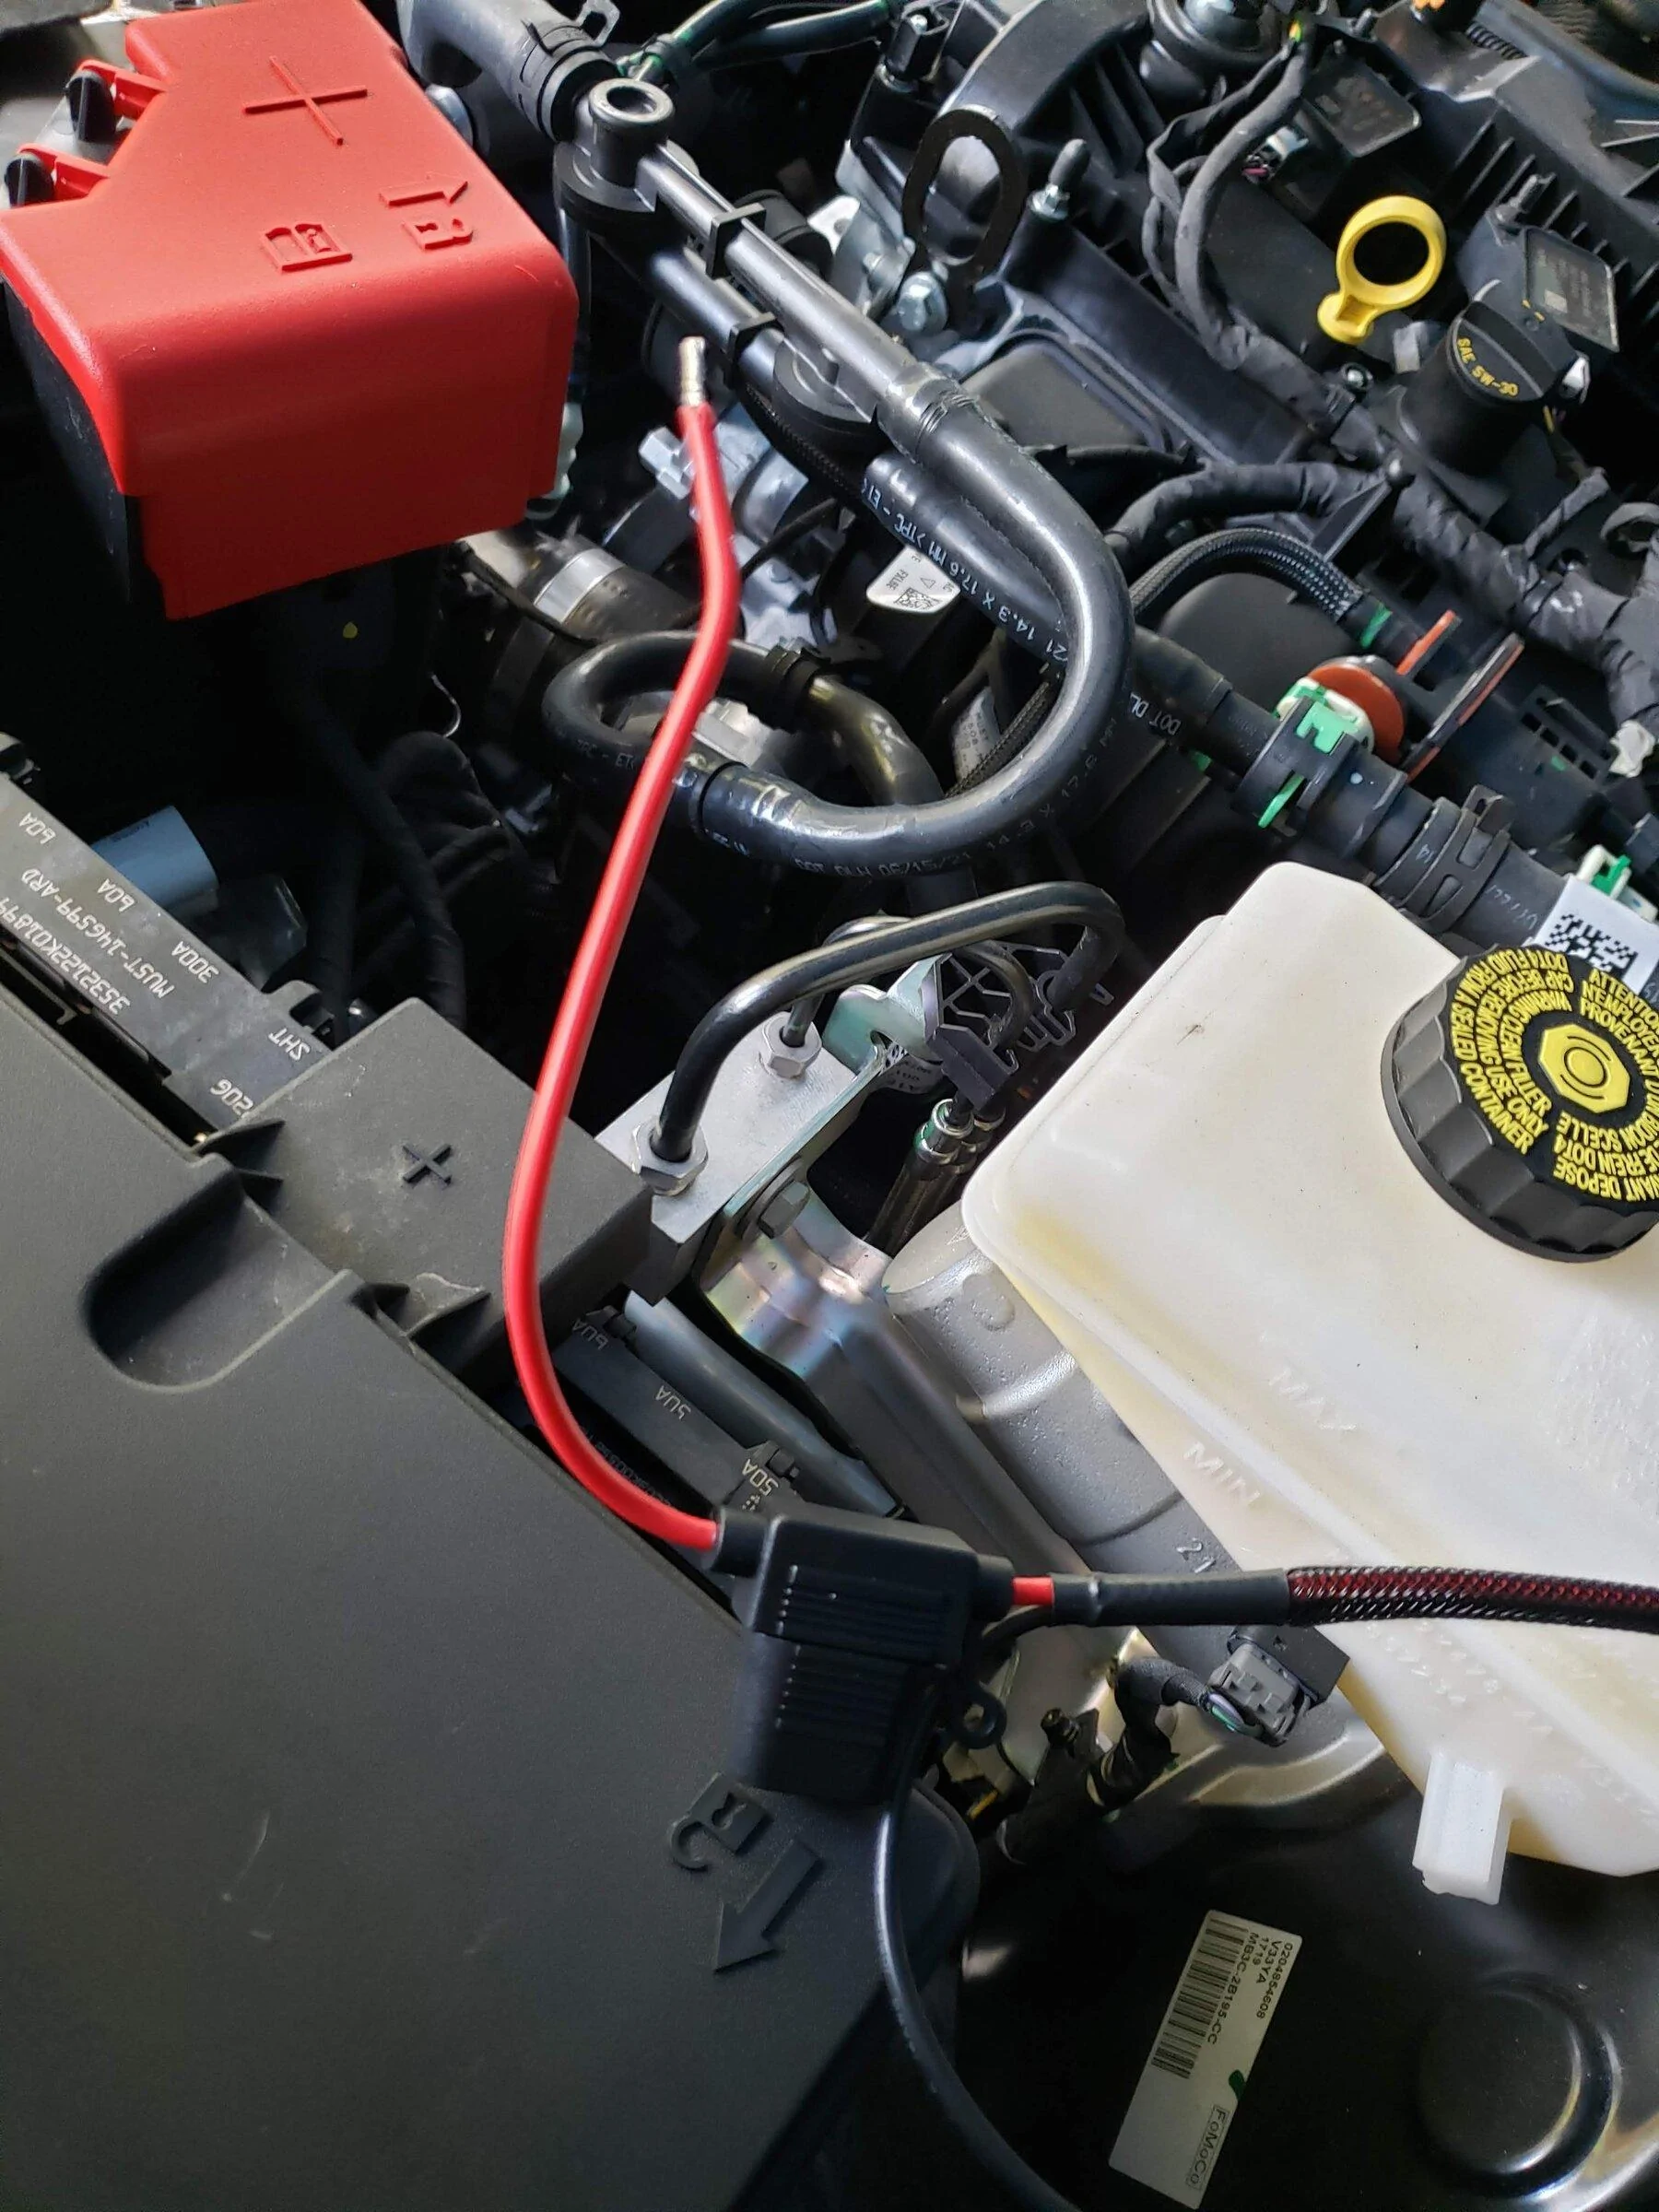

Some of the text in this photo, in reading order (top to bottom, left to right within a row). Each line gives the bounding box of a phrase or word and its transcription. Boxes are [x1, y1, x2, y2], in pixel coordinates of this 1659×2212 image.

[1457, 337, 1519, 397] SAE 5W-30
[928, 541, 947, 567] MM
[950, 561, 978, 595] 17.6
[982, 591, 995, 610] X
[998, 606, 1035, 640] 14.3
[1046, 640, 1068, 662] 21
[1148, 710, 1182, 735] DOT
[19, 812, 56, 845] 60A
[97, 877, 136, 912] 60A
[171, 940, 220, 983] 300A
[1488, 948, 1531, 975] FLUID
[1525, 948, 1569, 973] DOT4
[1459, 959, 1498, 999] FROM
[1454, 989, 1477, 1006] A
[268, 1028, 312, 1061] SHT
[1451, 1002, 1477, 1061] SEALED
[1580, 996, 1659, 1077] PROVENANT
[1476, 969, 1574, 1137] CAP BEFORE REMOVING USE ONLY
[1500, 990, 1572, 1117] WARNING CLEAN FILLER
[1461, 1063, 1534, 1154] CONTAINER
[1556, 1111, 1622, 1152] SCELLE
[1554, 1133, 1595, 1171] DOT4
[1597, 1149, 1647, 1176] FREIN
[1553, 1156, 1621, 1200] DEPOSE
[1183, 1441, 1261, 1501] MIN
[1190, 2108, 1227, 2185] FoMoCo
